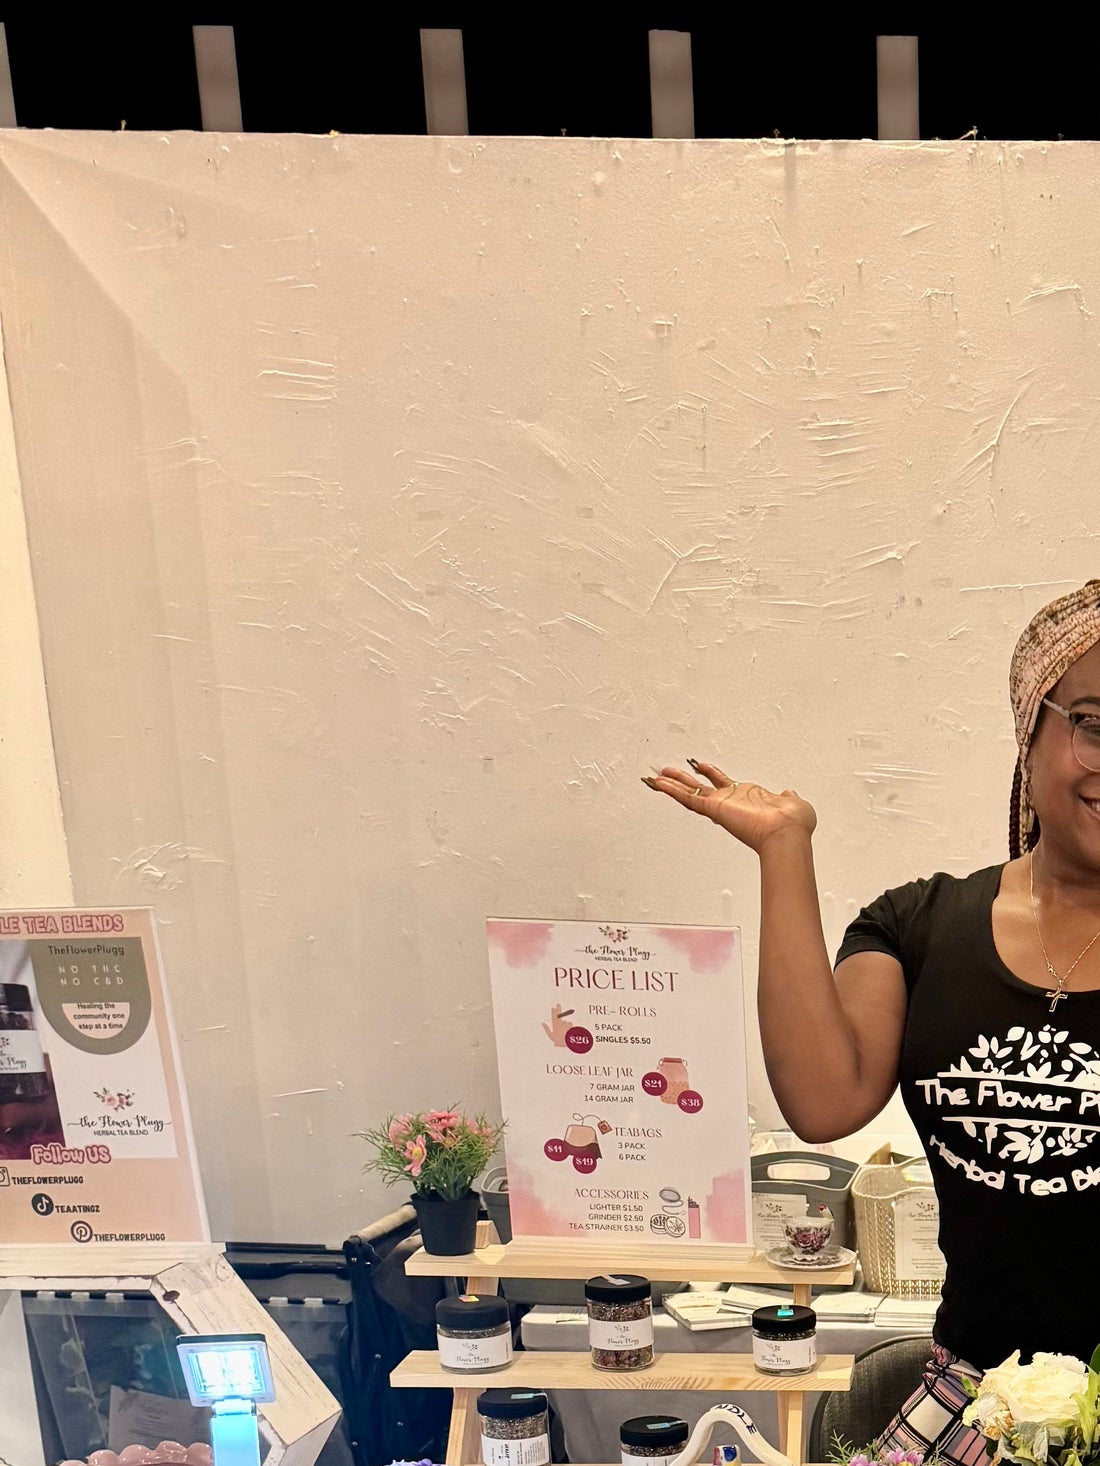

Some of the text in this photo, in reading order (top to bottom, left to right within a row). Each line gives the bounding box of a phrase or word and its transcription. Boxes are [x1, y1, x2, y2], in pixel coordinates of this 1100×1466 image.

[23, 915, 59, 934] TEA
[62, 914, 124, 933] BLENDS
[48, 945, 125, 956] TheFlowerPlugg
[58, 964, 121, 974] NO THC
[60, 977, 124, 986] NO CBD
[554, 967, 679, 992] PRICE LIST
[77, 1003, 102, 1011] Healing
[619, 1006, 657, 1018] ROLLS
[78, 1023, 93, 1031] step
[601, 1024, 623, 1032] PACK
[569, 1035, 589, 1045] $26
[595, 1036, 651, 1045] SINGLES $5.50
[546, 1064, 634, 1079] LOOSE LEAF JAR
[590, 1083, 595, 1091] 7
[621, 1084, 635, 1092] JAR
[595, 1095, 618, 1103] GRAM
[915, 1078, 970, 1105] The
[977, 1080, 1072, 1112] Flower
[680, 1098, 700, 1107] $38
[99, 1115, 133, 1127] Flower
[135, 1115, 172, 1132] Plugg
[613, 1127, 663, 1138] TEABAGS
[624, 1142, 646, 1150] PACK
[32, 1143, 112, 1165] Follow US
[12, 1176, 84, 1185] THEFLOWERPLUGG
[1013, 1173, 1068, 1196] Tea
[575, 1188, 650, 1200] ACCESSORIES
[589, 1203, 643, 1212] LIGHTER $1.50
[588, 1213, 622, 1221] GRINDER
[569, 1222, 644, 1232] TEA STRAINER $3.50
[94, 1233, 166, 1242] THEFLOWERPLUGG
